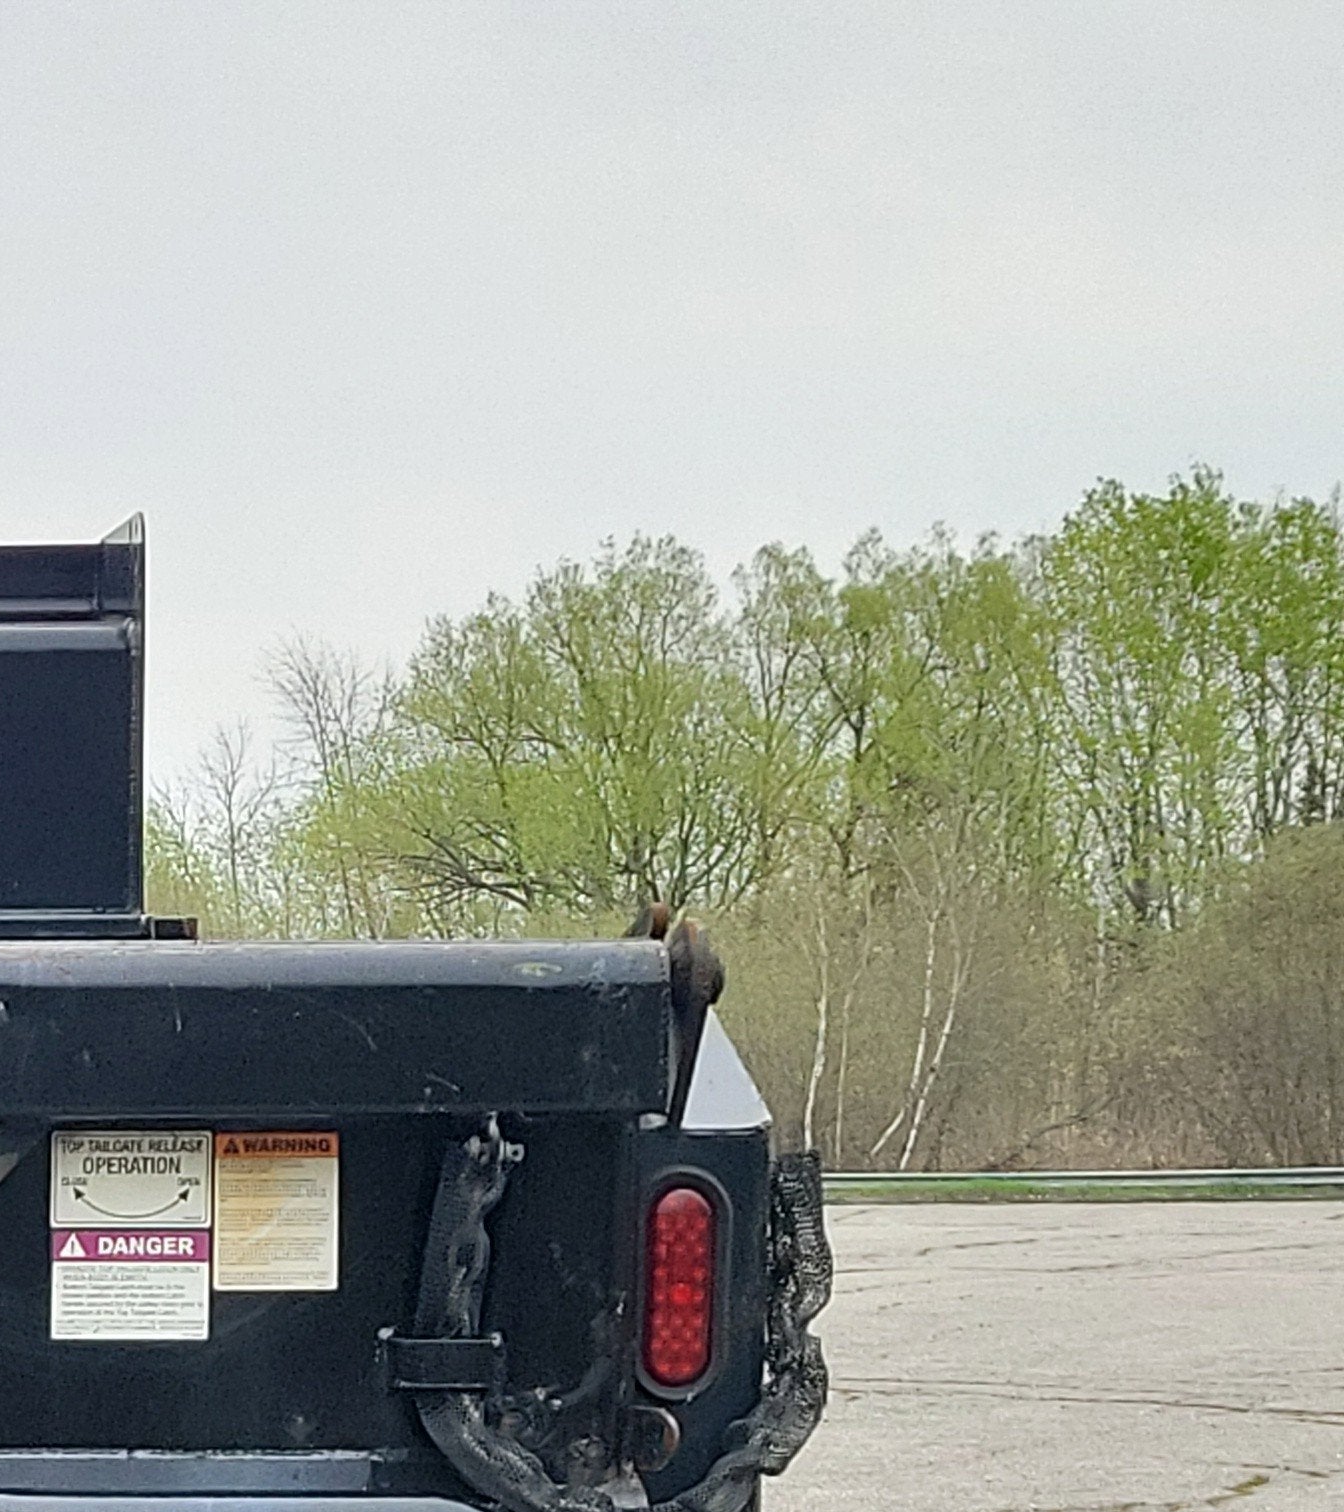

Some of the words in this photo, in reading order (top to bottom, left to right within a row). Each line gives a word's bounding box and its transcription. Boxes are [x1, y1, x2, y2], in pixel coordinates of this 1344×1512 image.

[242, 1138, 330, 1153] WARNING
[83, 1156, 181, 1174] OPERATION
[98, 1236, 195, 1256] DANGER
